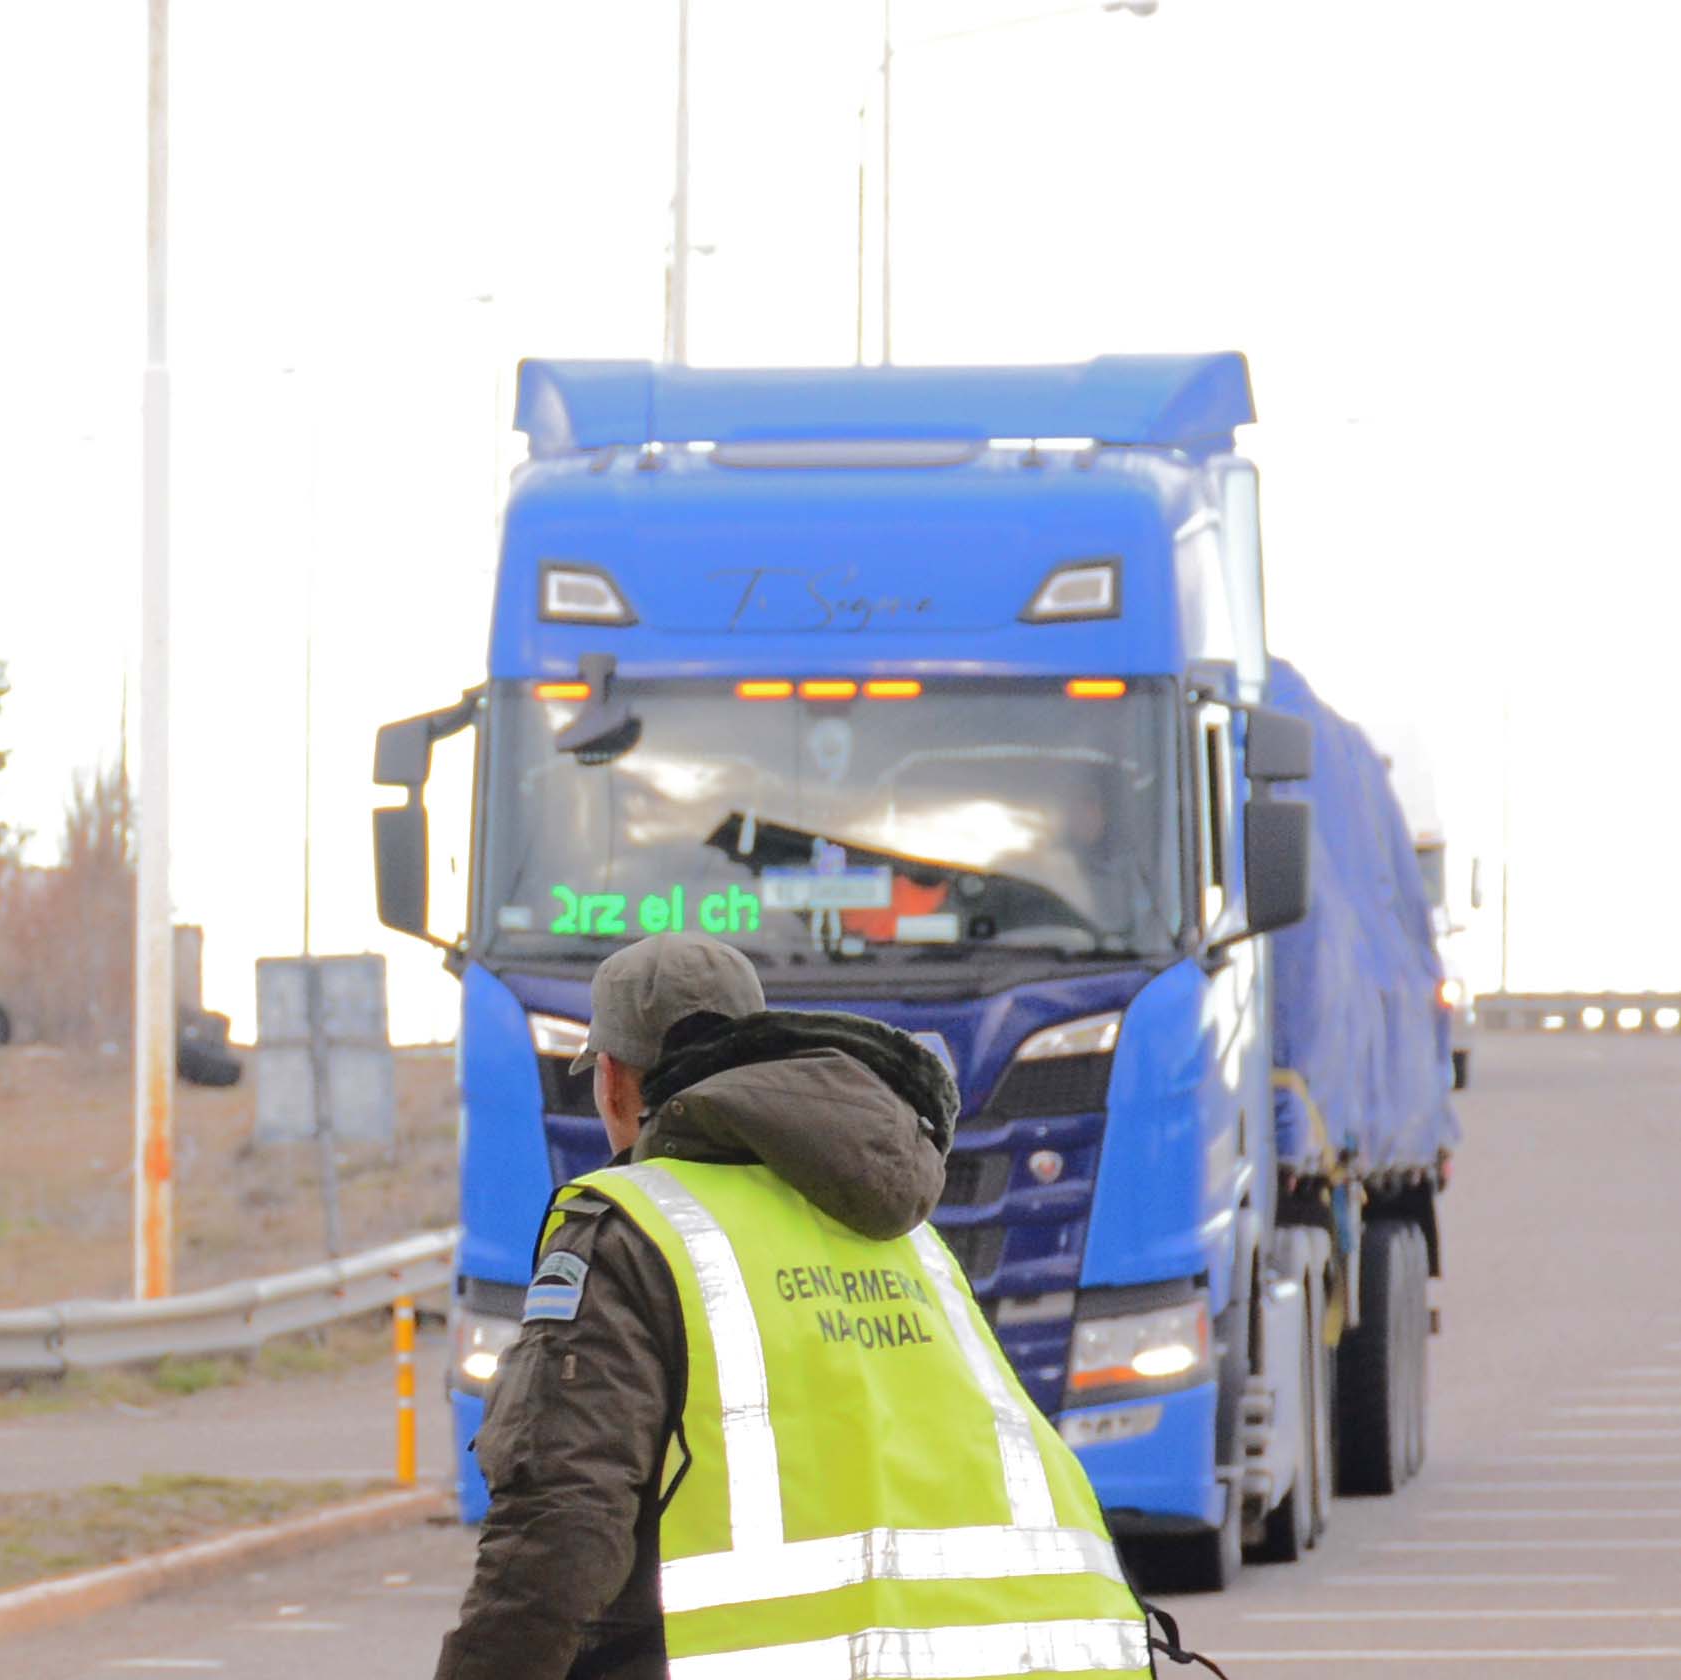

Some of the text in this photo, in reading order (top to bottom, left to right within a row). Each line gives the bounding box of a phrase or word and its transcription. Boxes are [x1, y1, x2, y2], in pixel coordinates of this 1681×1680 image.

[639, 884, 685, 935] el
[699, 884, 761, 935] ch
[817, 1309, 932, 1349] NAONAL
